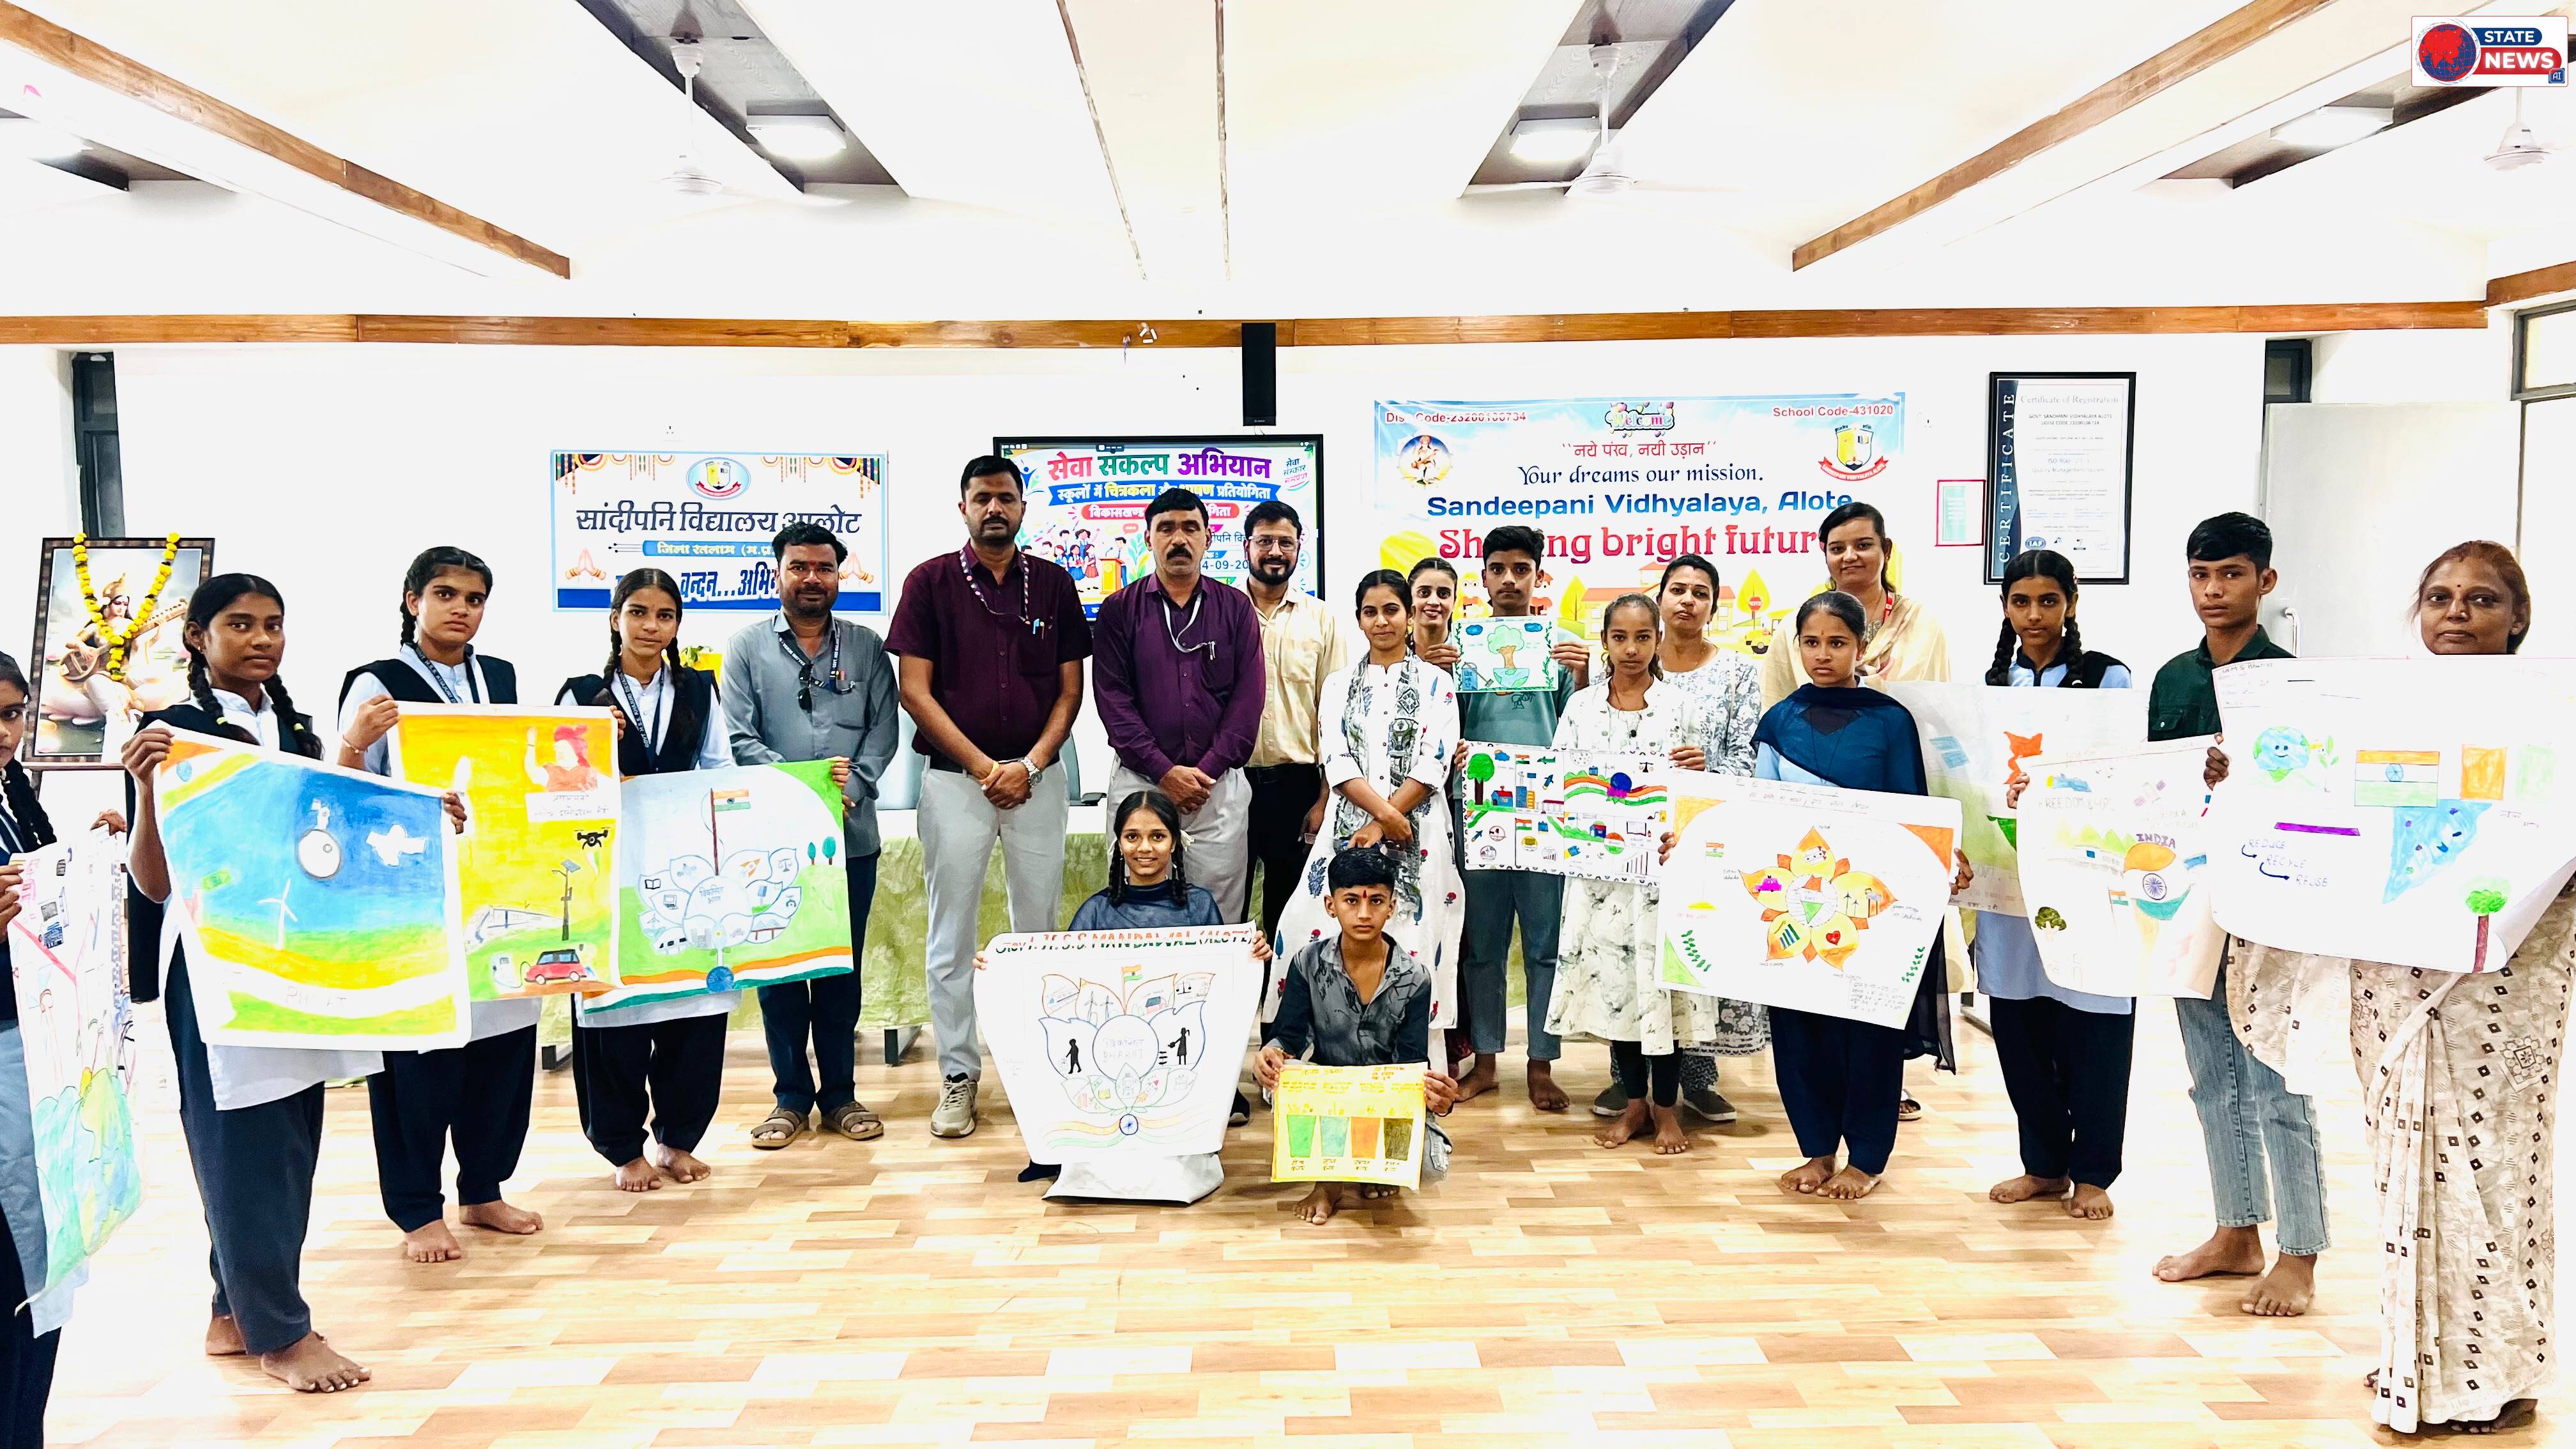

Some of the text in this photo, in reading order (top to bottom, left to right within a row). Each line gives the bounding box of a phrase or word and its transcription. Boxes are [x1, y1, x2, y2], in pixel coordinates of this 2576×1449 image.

[2020, 395, 2119, 404] Certificate of Registration
[1611, 411, 1673, 429] Welcome
[1773, 405, 1894, 417] School Code-431020
[1638, 439, 1666, 457] नयी
[1047, 447, 1273, 481] सेवा संकल्प अभियान
[1286, 457, 1300, 467] सेवा
[1517, 463, 1763, 486] Your dreams our mission.
[1999, 394, 2015, 563] CERTIFICATE
[1057, 482, 1091, 503] स्कूलों
[1092, 482, 1103, 498] में
[1103, 481, 1156, 498] चित्रकला
[1216, 482, 1271, 500] प्रतियोगिता
[1427, 490, 1853, 519] Sandeepani Vidhyalaya, Alote
[576, 500, 677, 534] सांदीपनि
[679, 502, 779, 533] विद्यालय
[657, 540, 690, 555] जिला
[692, 544, 735, 556] रतलाम
[1439, 524, 1825, 564] Shng bright futur
[2136, 832, 2176, 848] INDIA
[2249, 839, 2285, 849] REDUCE
[2296, 874, 2328, 887] REUSE
[1091, 931, 1197, 949] MANDAWAL
